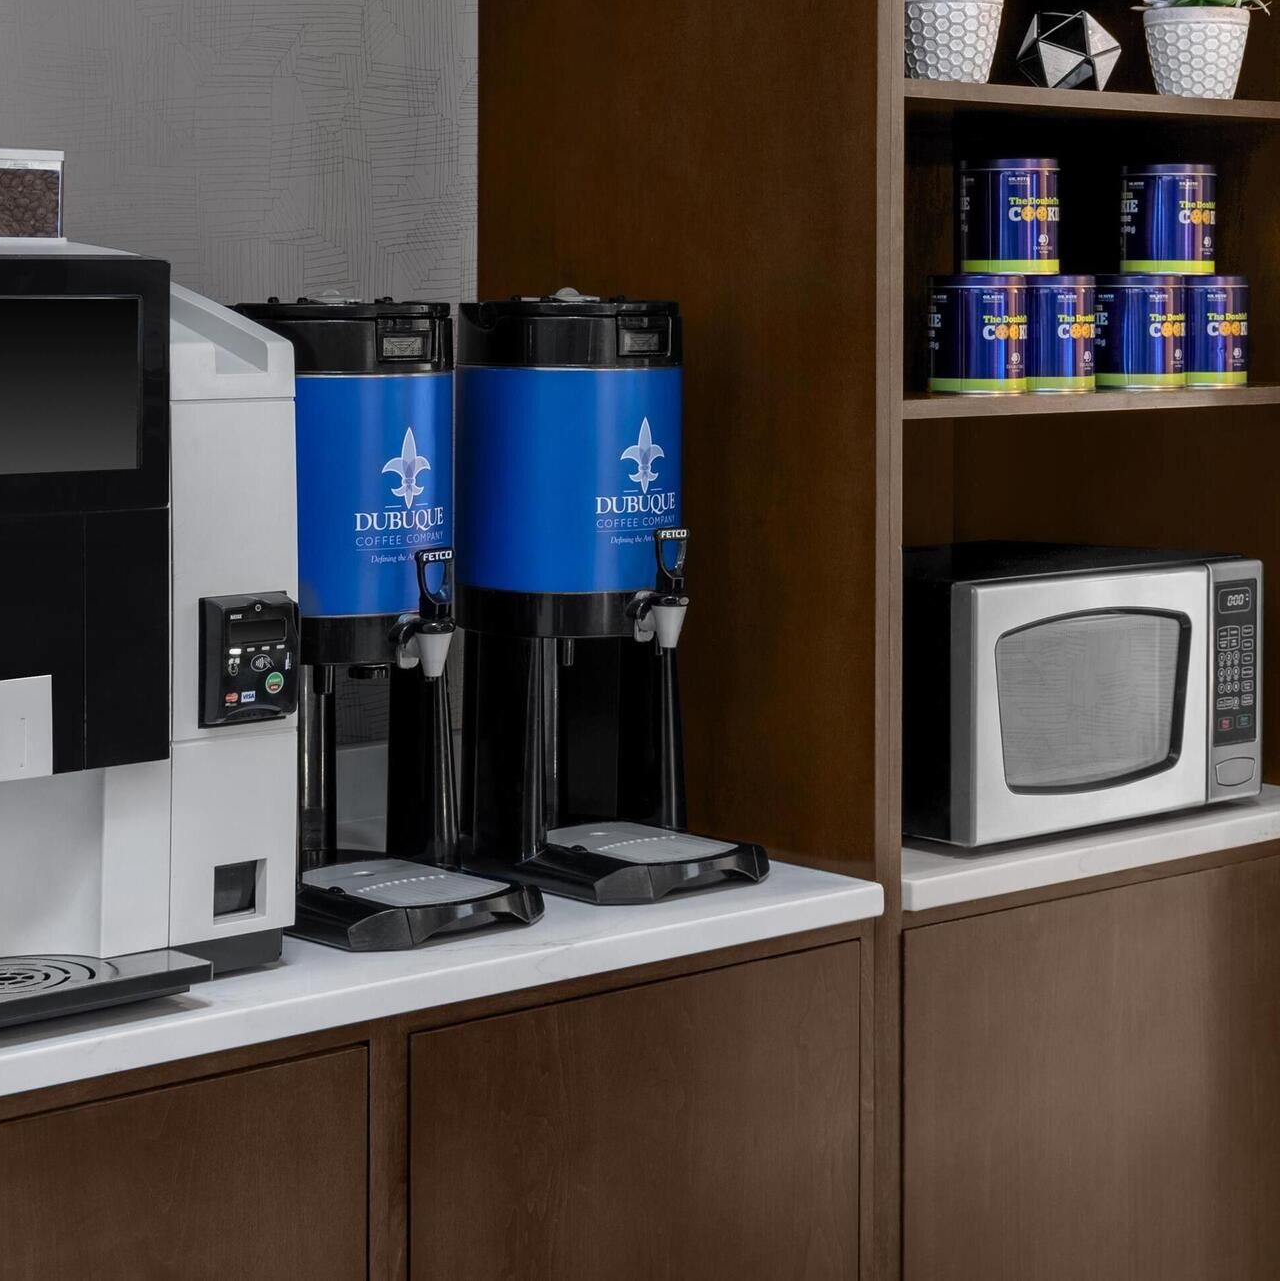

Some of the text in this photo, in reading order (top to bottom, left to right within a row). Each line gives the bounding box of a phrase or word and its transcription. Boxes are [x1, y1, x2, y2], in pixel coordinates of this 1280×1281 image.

[596, 492, 676, 514] DUBUQUE
[354, 507, 444, 531] DUBUQUE
[596, 515, 675, 528] COFFEE COMPANY
[355, 531, 443, 547] COFFEE COMPANY
[661, 529, 687, 539] FETCO
[423, 550, 452, 561] FETCO
